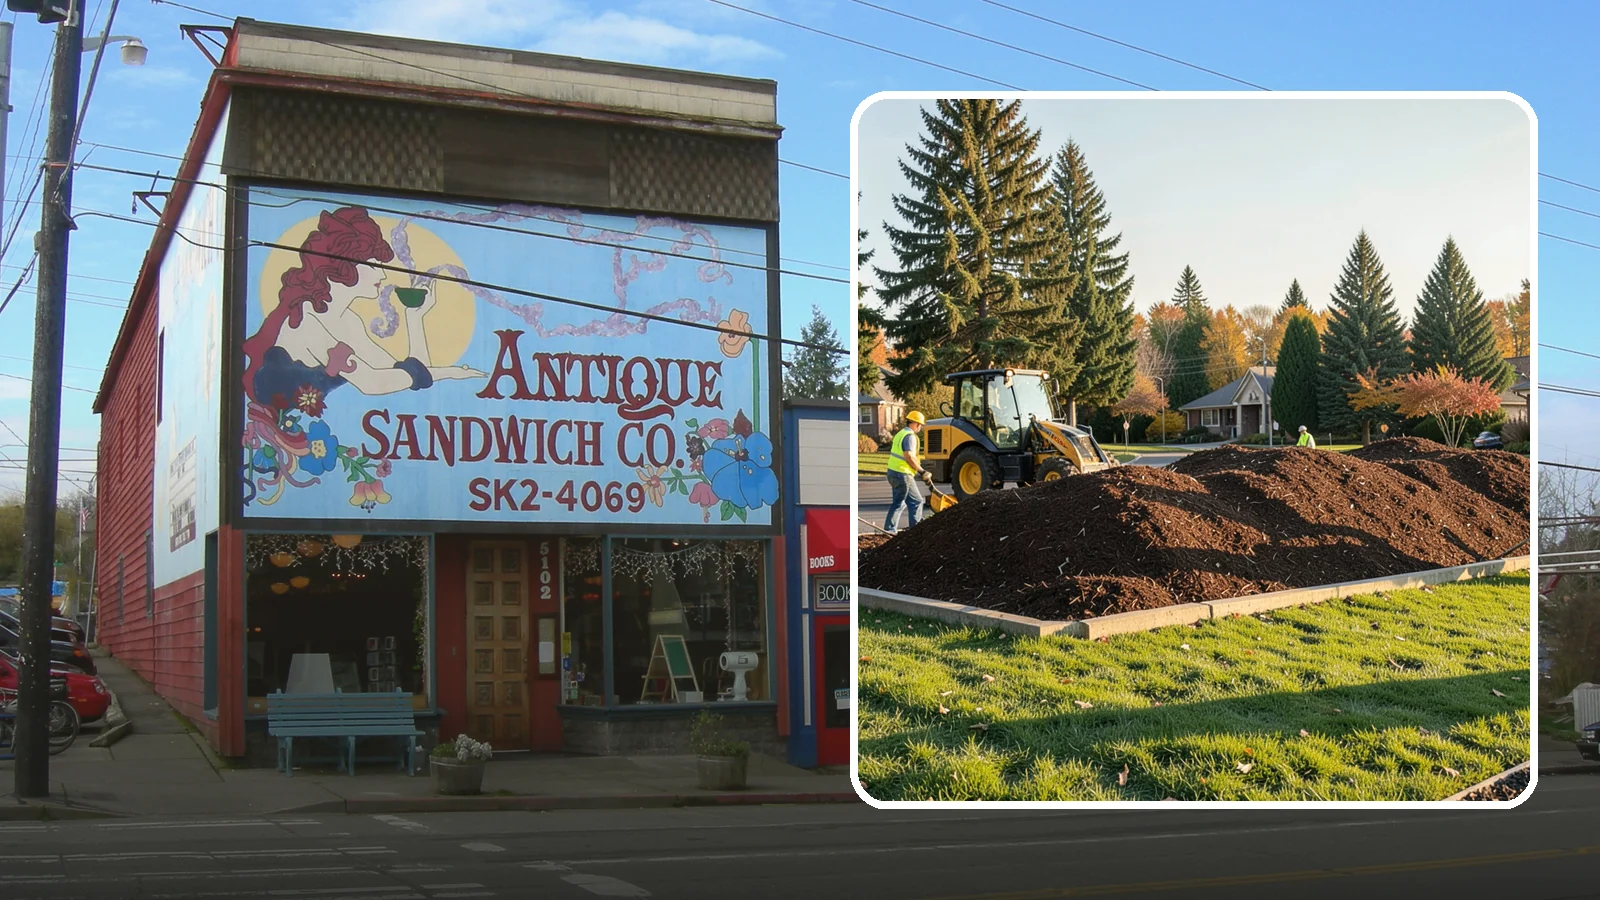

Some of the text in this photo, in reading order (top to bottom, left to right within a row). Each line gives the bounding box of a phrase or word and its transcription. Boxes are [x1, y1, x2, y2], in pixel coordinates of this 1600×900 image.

[475, 328, 724, 421] ANTIQUE
[361, 408, 685, 469] SANDWICH CO.
[468, 476, 646, 513] SK2-4069
[540, 541, 551, 600] 5102
[809, 555, 835, 569] BOOKS
